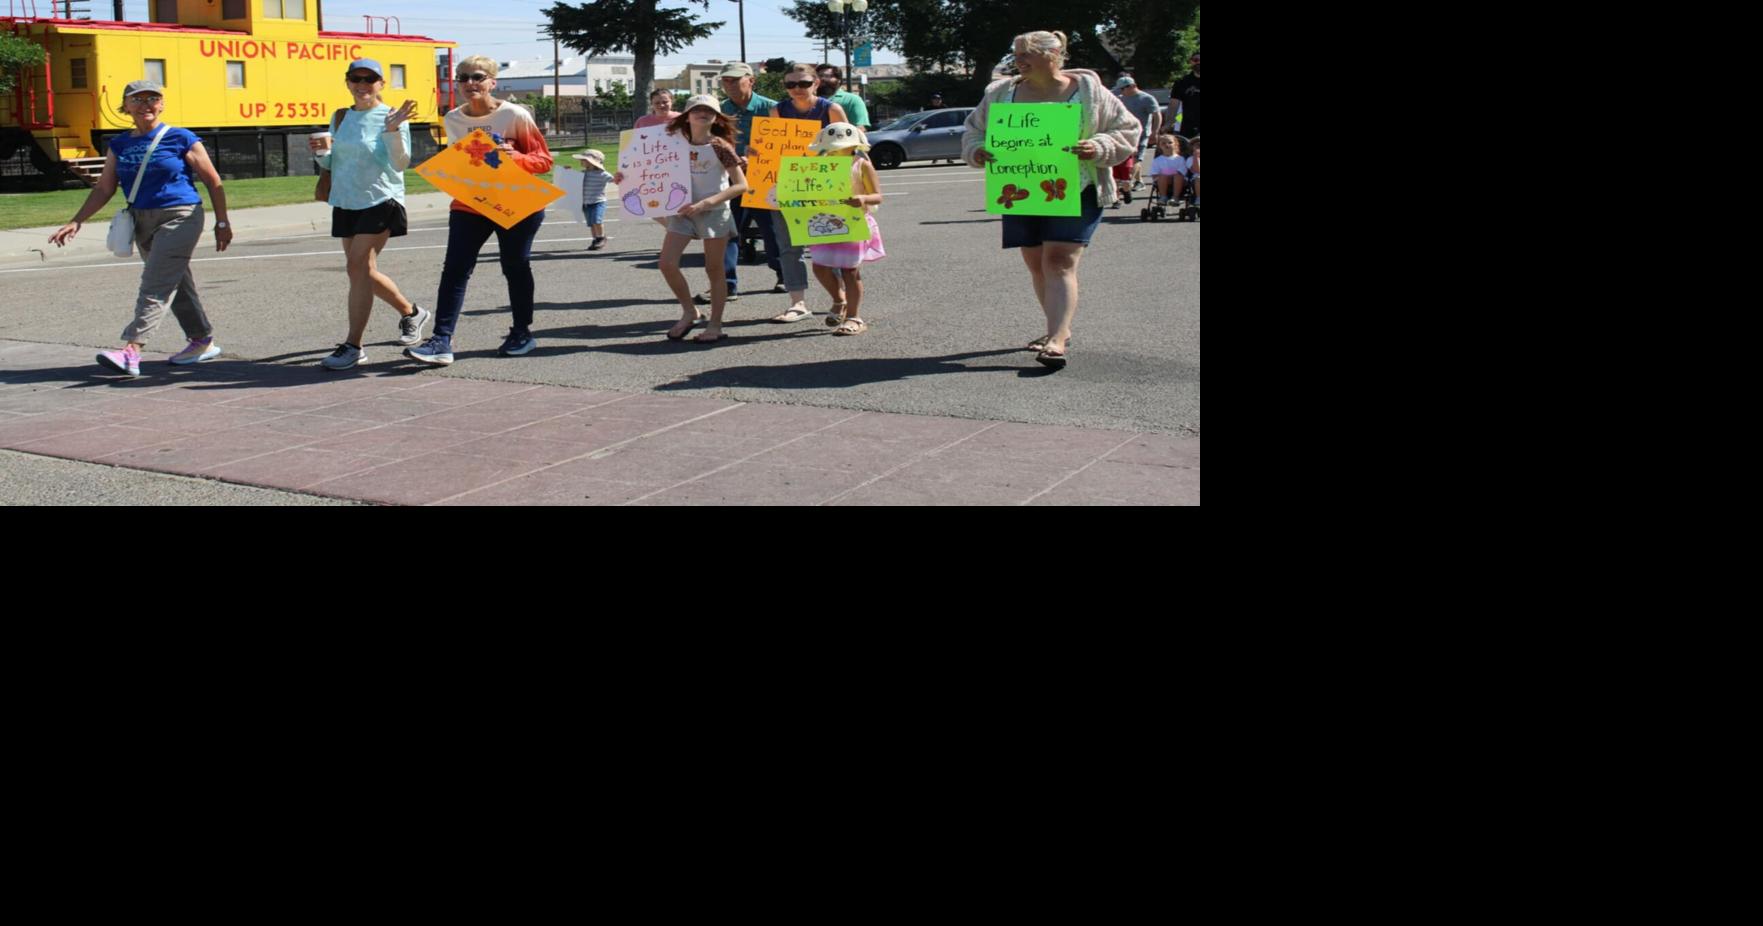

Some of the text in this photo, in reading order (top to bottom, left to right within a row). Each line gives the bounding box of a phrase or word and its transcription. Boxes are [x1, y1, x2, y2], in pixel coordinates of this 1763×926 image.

[200, 40, 362, 60] UNION PACIFIC
[240, 103, 326, 118] UP 25351
[1007, 112, 1040, 128] Life
[760, 120, 813, 138] God has
[643, 140, 668, 155] Life
[765, 141, 804, 155] a plan
[991, 134, 1053, 152] begins at
[655, 152, 680, 165] Gift
[640, 169, 670, 181] from
[789, 162, 839, 174] EVERY
[640, 182, 664, 196] God
[796, 179, 823, 193] Life
